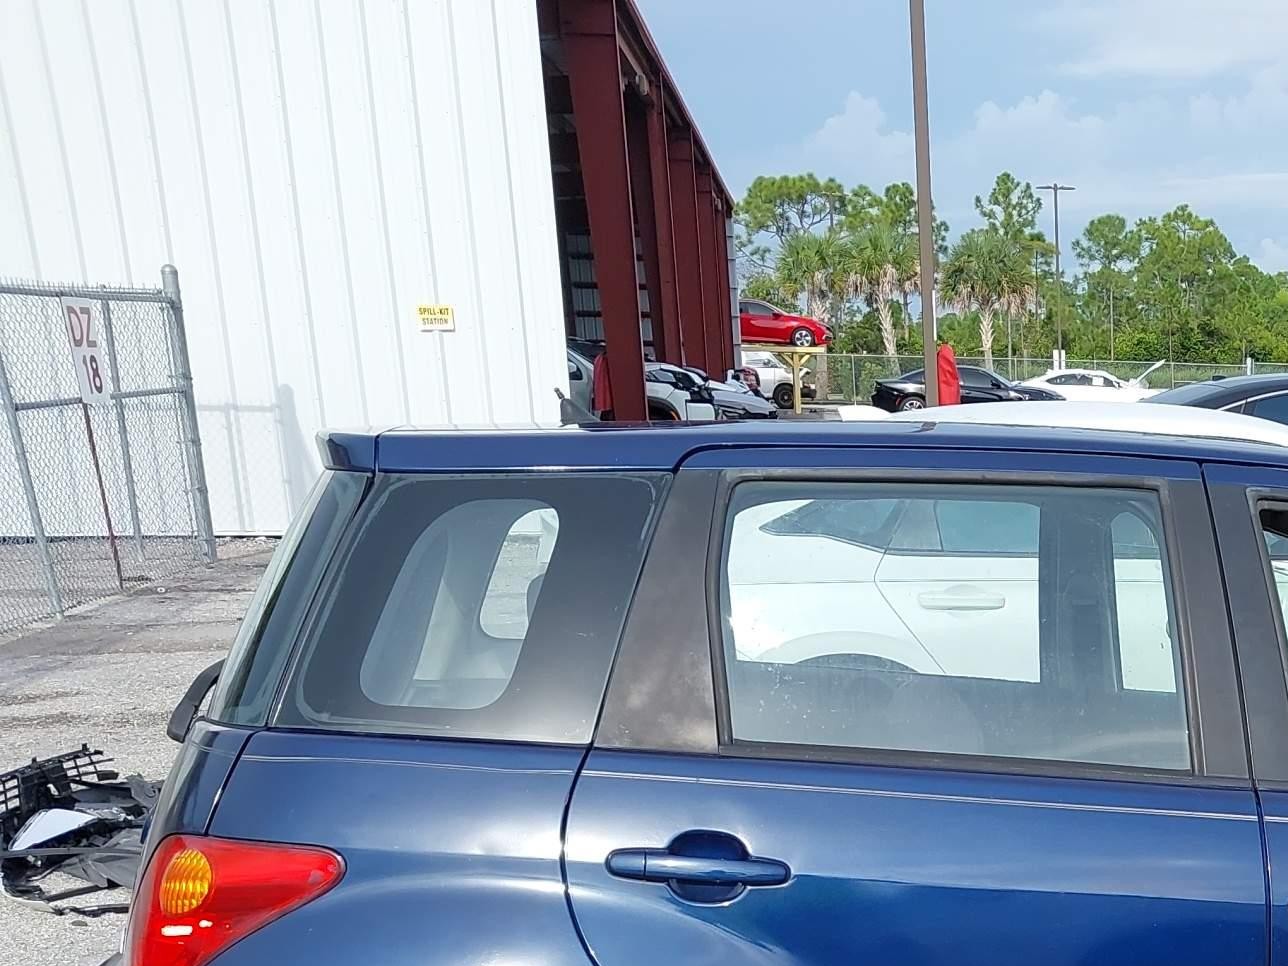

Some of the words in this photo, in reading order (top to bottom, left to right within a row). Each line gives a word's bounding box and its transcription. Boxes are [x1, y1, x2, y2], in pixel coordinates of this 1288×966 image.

[418, 307, 449, 315] SPILL-KIT
[422, 317, 449, 325] STATION
[66, 306, 97, 347] DZ
[83, 354, 103, 394] 18
